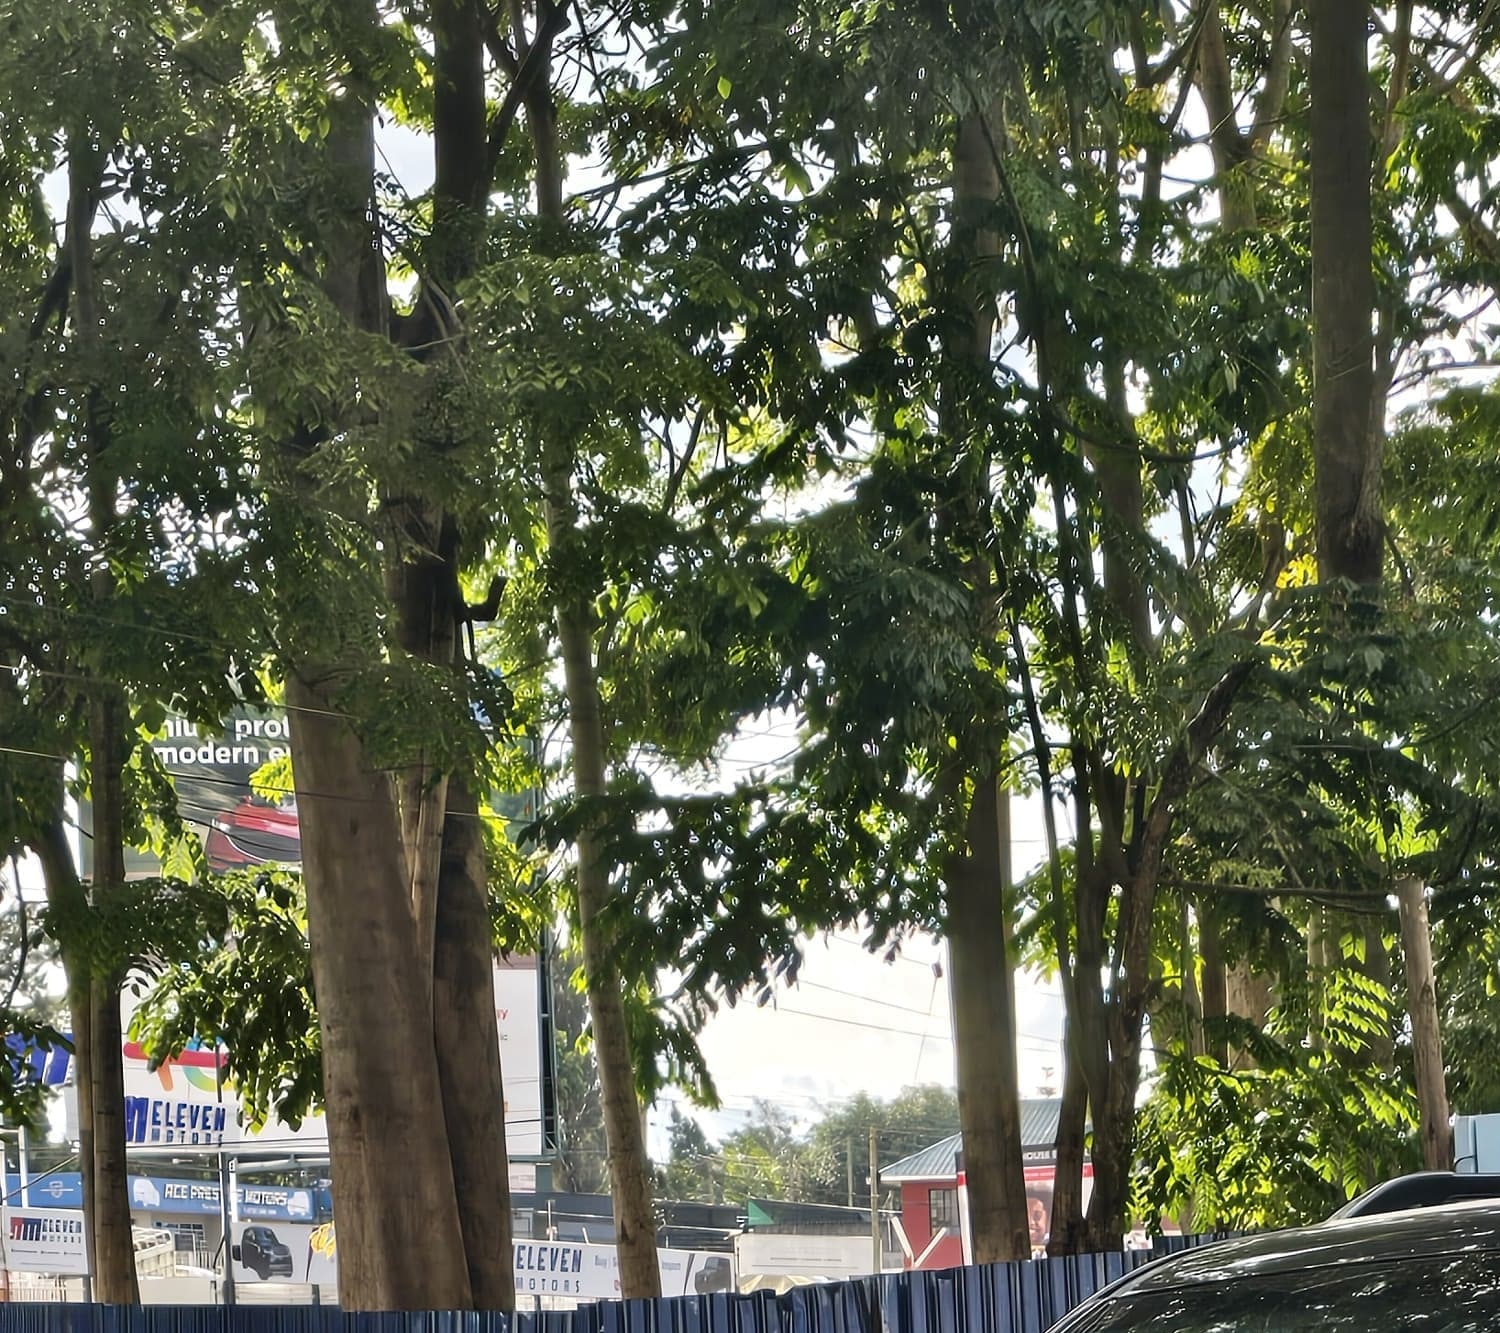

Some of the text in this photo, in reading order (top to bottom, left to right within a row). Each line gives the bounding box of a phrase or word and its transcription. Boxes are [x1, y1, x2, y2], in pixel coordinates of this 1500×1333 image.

[153, 742, 259, 764] modern
[151, 1101, 226, 1131] ELEVEN
[164, 1183, 188, 1199] ACE
[516, 1245, 582, 1273] ELEVEN
[516, 1277, 580, 1293] MOTORS
